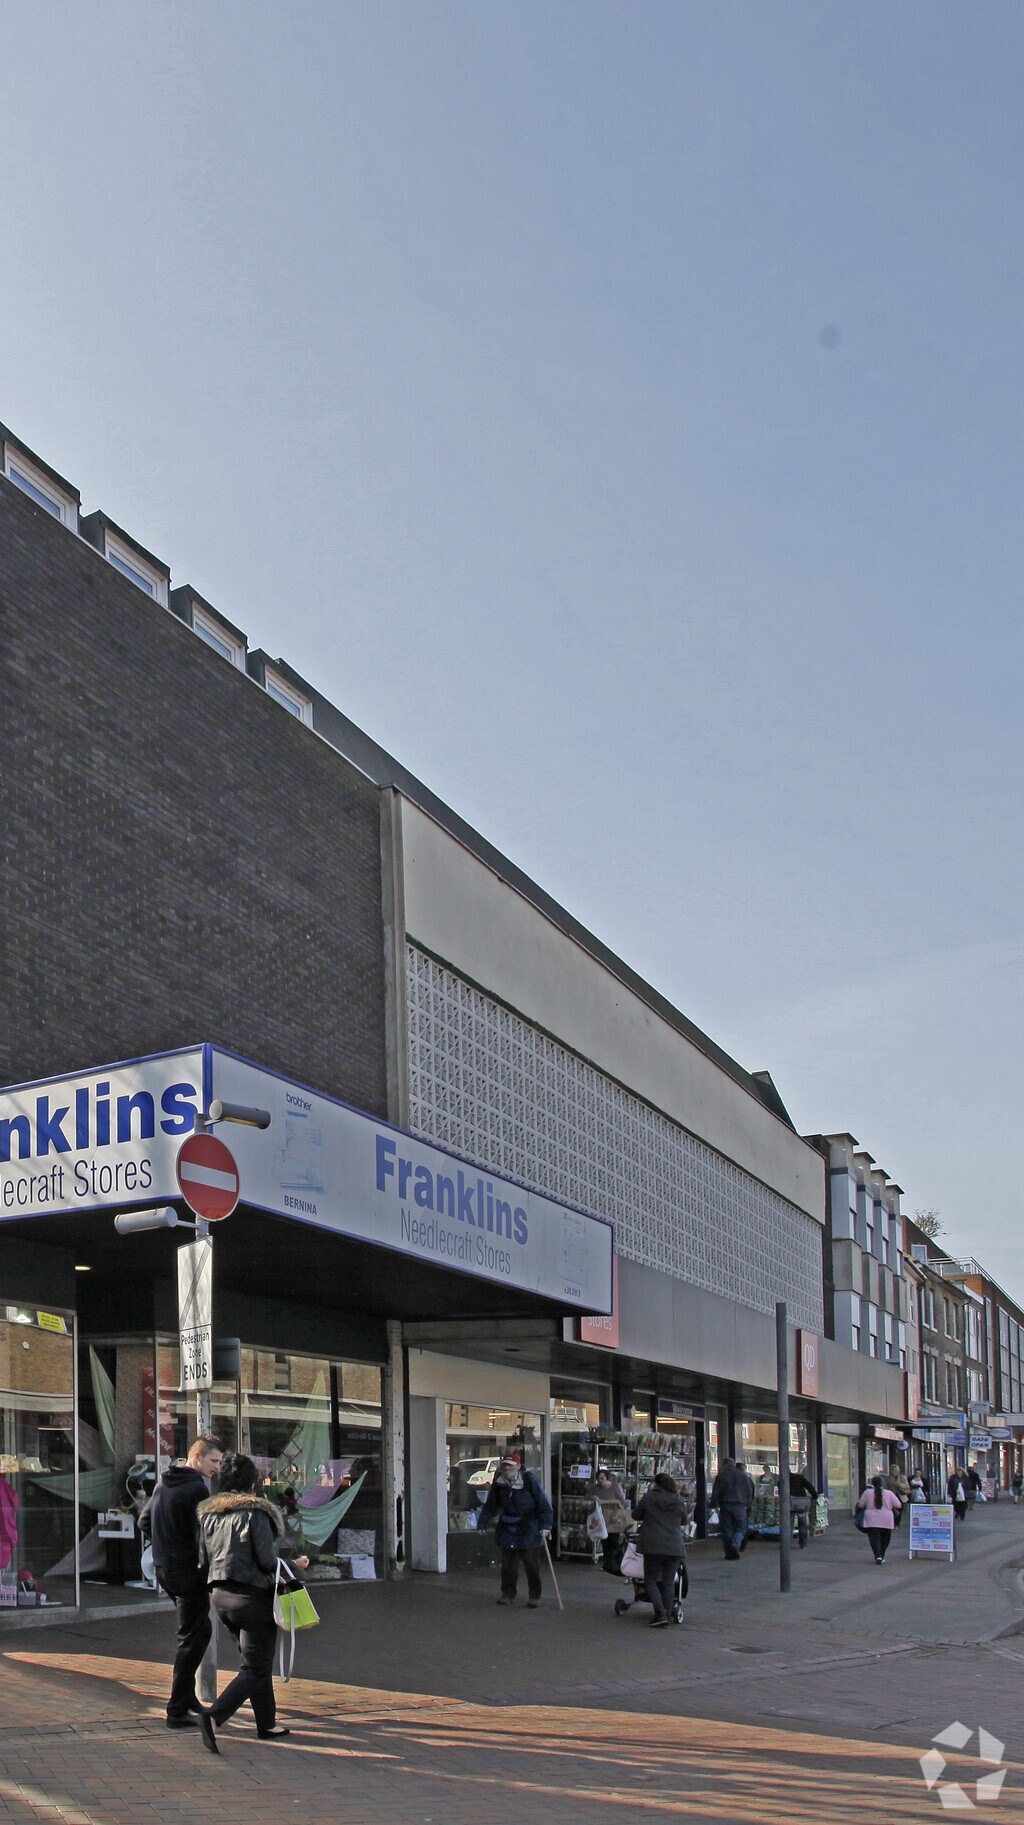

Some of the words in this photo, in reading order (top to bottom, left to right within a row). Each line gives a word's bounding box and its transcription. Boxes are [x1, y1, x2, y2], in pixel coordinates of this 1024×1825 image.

[286, 1091, 312, 1111] brother
[74, 1159, 152, 1197] Stores
[376, 1134, 528, 1245] Franklins
[284, 1195, 317, 1215] BERNINA
[401, 1208, 472, 1262] Needlecraft
[476, 1235, 511, 1275] Stores
[181, 1331, 209, 1345] Pedestrian
[189, 1348, 201, 1358] Zone
[805, 1344, 815, 1371] QD
[184, 1361, 207, 1380] ENDS
